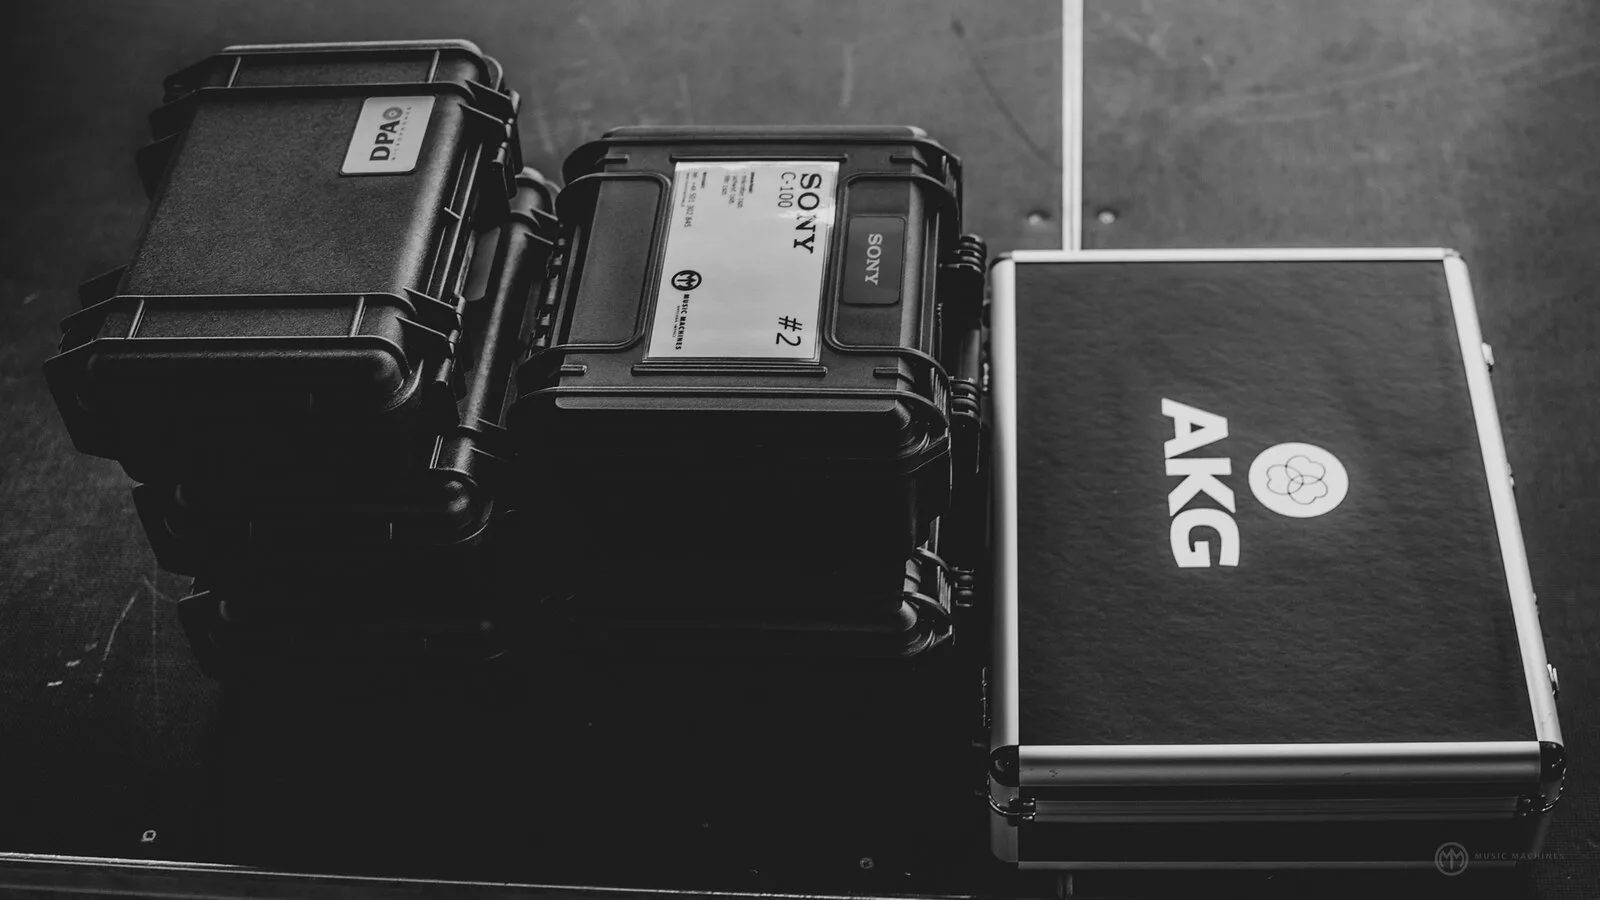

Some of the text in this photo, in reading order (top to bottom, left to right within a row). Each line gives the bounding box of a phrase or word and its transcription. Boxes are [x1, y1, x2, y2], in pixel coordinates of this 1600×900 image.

[369, 120, 400, 161] DPA
[778, 171, 796, 208] C-100
[793, 173, 822, 254] SONY
[865, 233, 882, 286] SONY
[681, 294, 690, 314] MUSIC
[675, 316, 686, 350] MACHINES
[776, 316, 803, 346] #2
[1161, 397, 1240, 567] AKG
